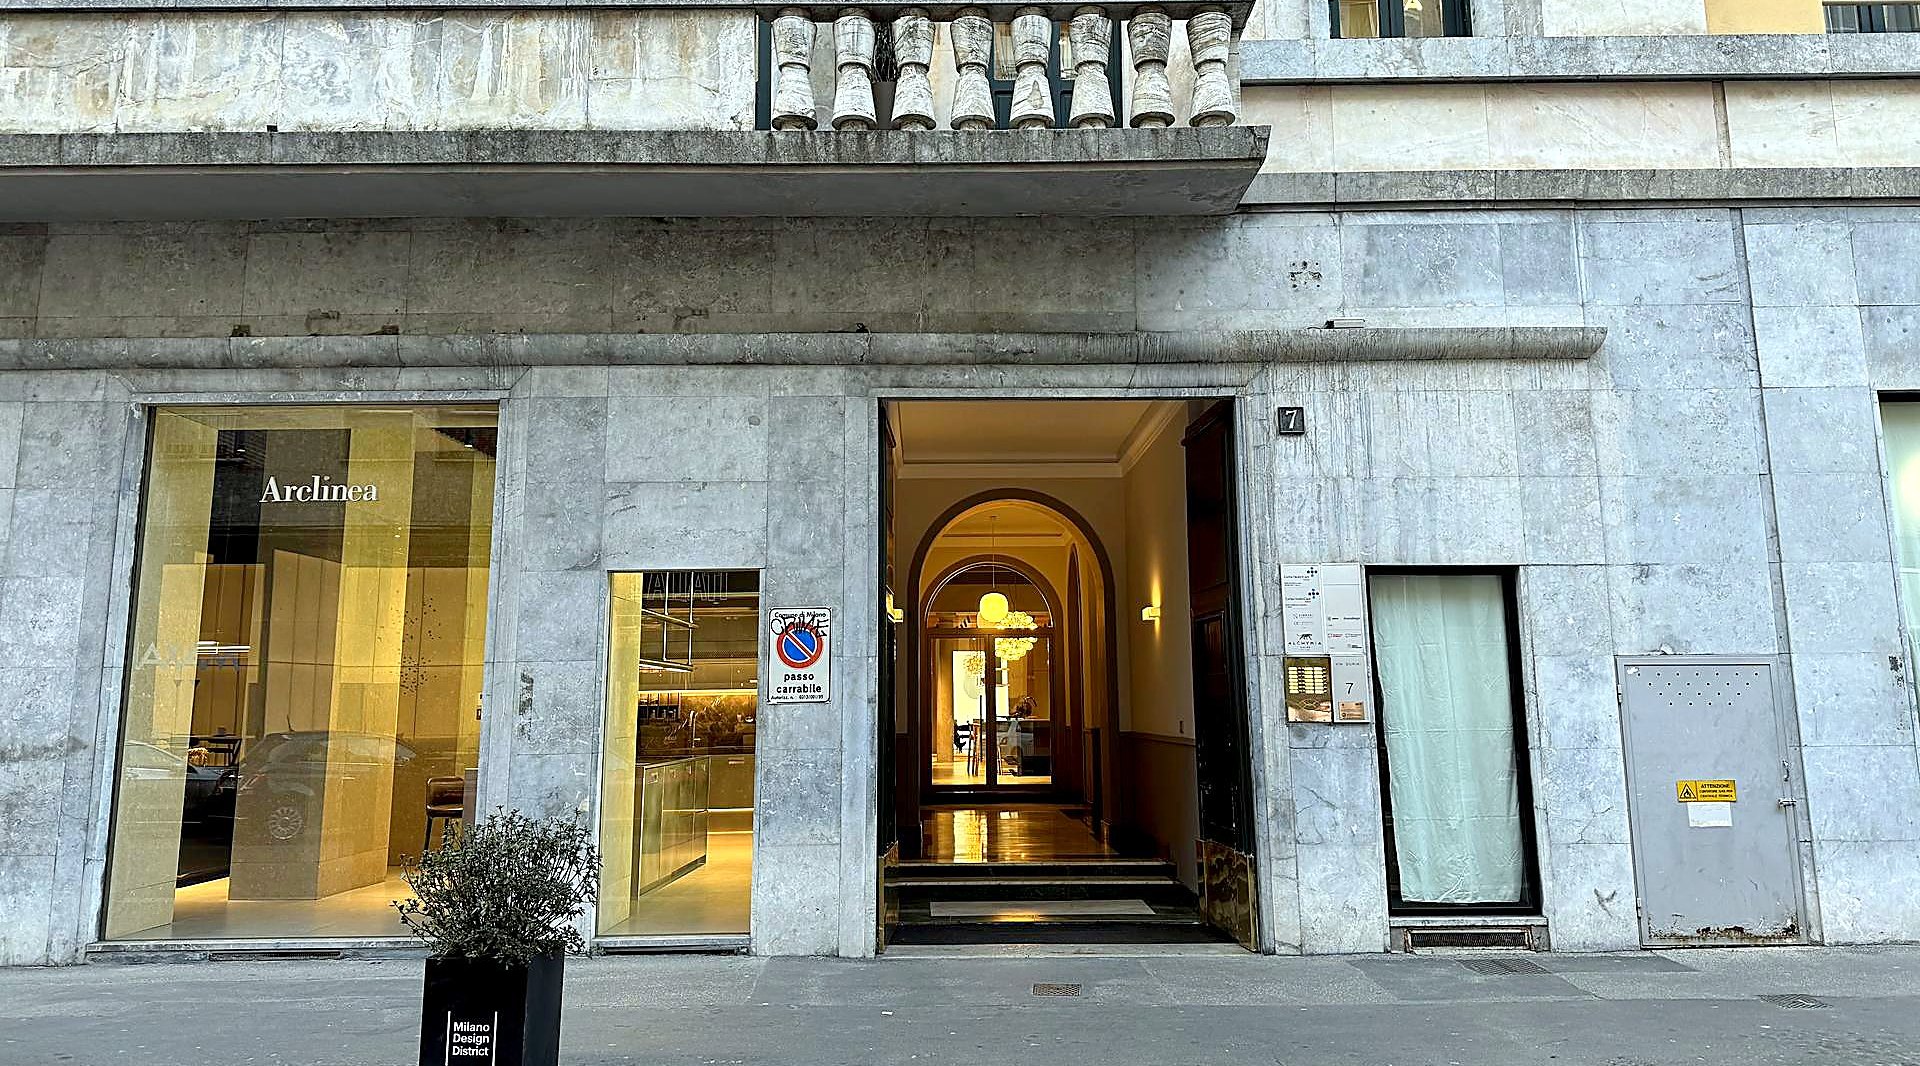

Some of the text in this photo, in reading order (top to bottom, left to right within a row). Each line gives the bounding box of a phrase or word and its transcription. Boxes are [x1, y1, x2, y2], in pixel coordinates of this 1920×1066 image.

[1286, 410, 1297, 428] 7
[259, 475, 378, 502] Arclinea
[784, 673, 815, 682] passo
[776, 684, 822, 693] carrabile
[1346, 683, 1354, 694] 7
[453, 1021, 490, 1032] Milano
[453, 1033, 490, 1045] Design
[452, 1045, 490, 1056] District
